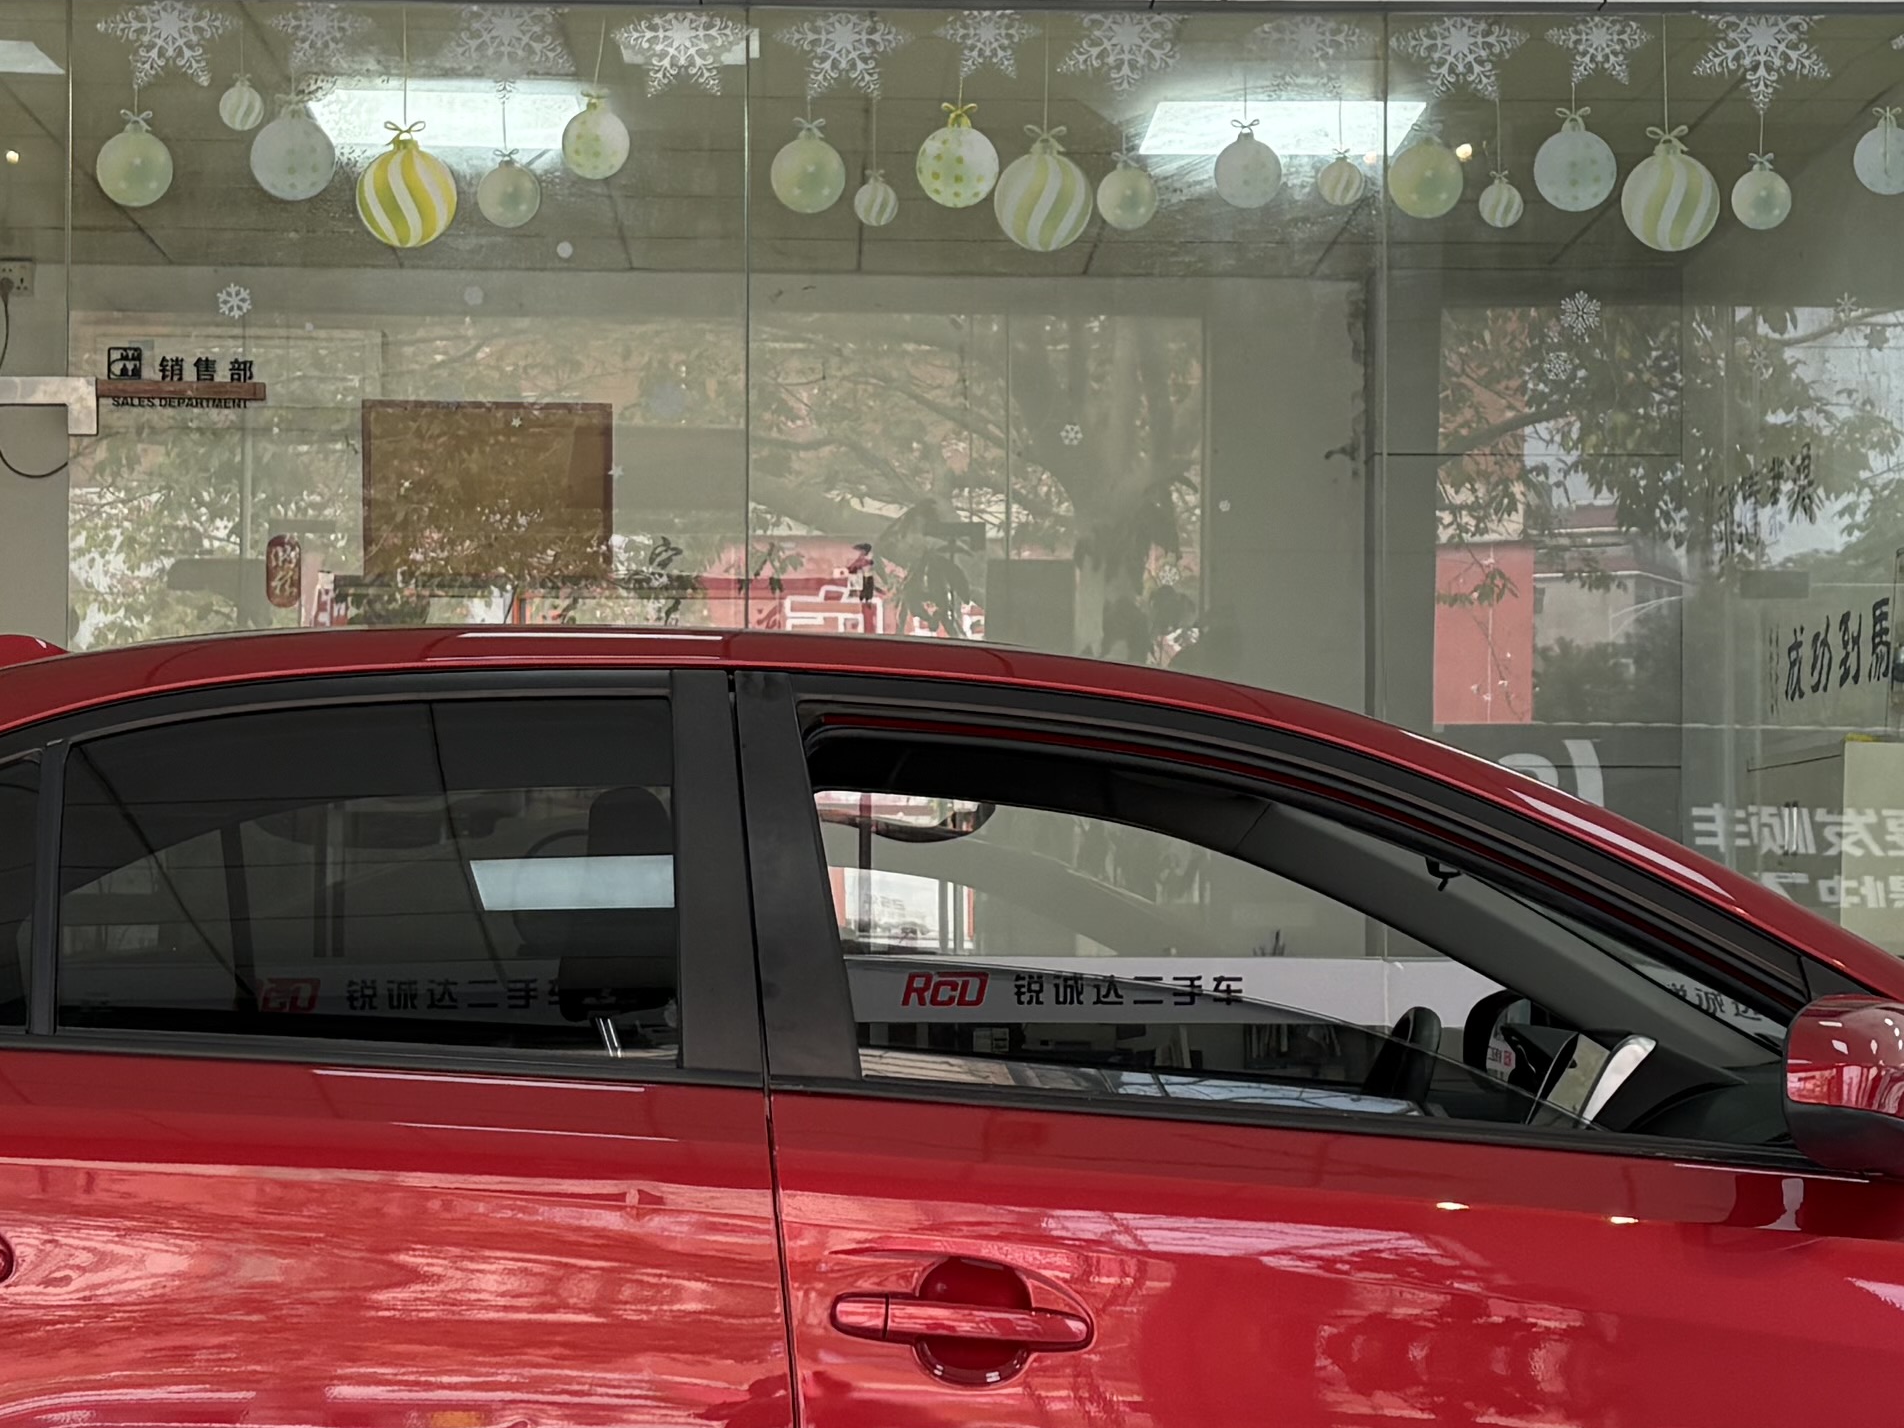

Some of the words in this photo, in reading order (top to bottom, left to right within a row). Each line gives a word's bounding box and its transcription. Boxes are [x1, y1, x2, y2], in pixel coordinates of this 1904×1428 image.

[158, 355, 255, 383] 销售部
[111, 396, 156, 408] SALES
[1013, 972, 1244, 1007] 锐诚达二手车
